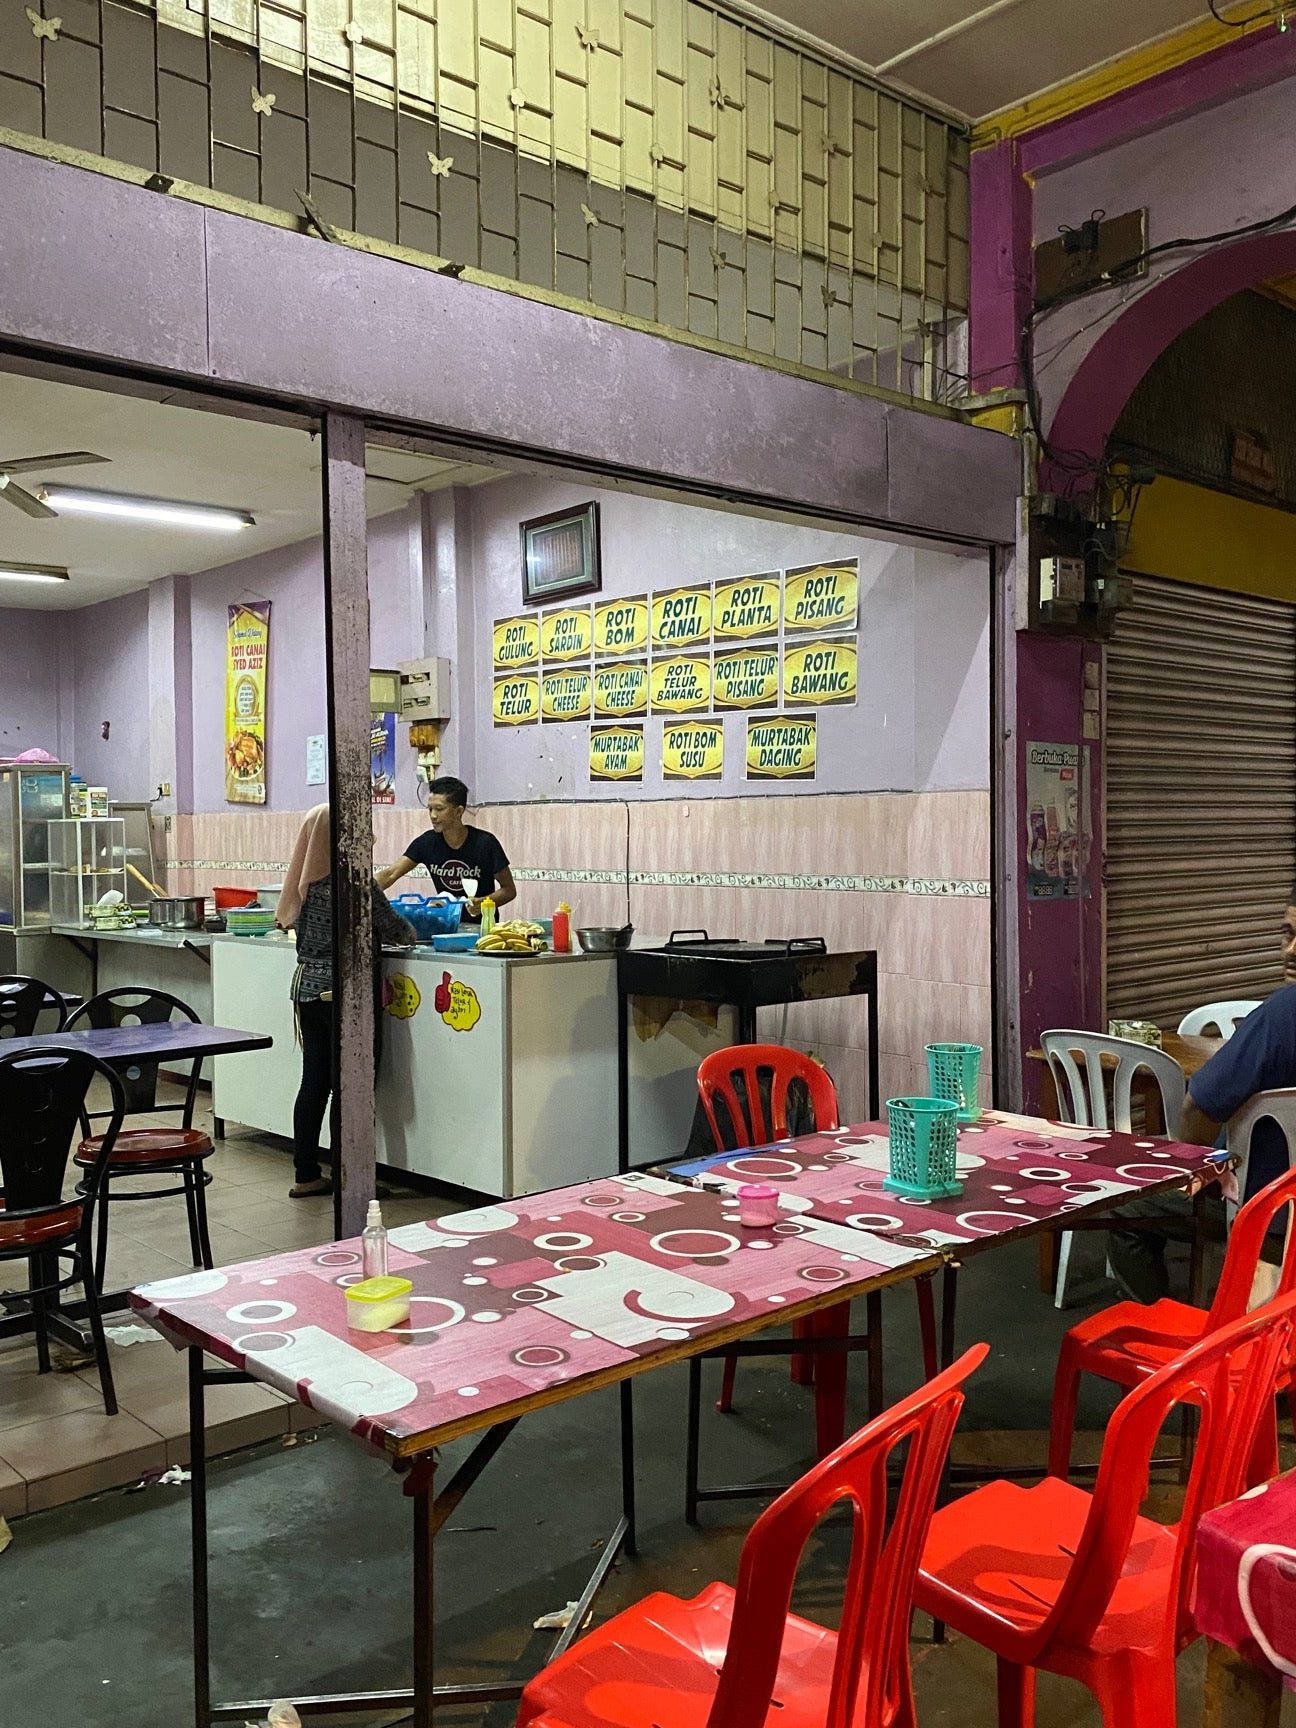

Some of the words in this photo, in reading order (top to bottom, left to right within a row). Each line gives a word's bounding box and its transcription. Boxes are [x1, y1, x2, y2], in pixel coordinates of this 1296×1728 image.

[804, 576, 837, 598] ROTI
[731, 586, 764, 608] ROTI
[662, 596, 698, 619] ROTI
[721, 605, 772, 628] PLANTA
[794, 596, 846, 621] PISANG
[554, 617, 578, 636] ROTI
[605, 608, 635, 628] ROTI
[505, 626, 526, 645] ROTI
[605, 626, 635, 645] BOM
[658, 617, 702, 640] CANAI
[246, 644, 265, 655] CANAI
[498, 642, 533, 661] GULUNG
[548, 634, 583, 653] SARDIN
[233, 660, 247, 670] SYED
[249, 658, 263, 669] AZIZ
[666, 664, 693, 677] ROTI
[716, 660, 741, 680] ROTI
[742, 656, 775, 678] TELUR
[803, 651, 837, 672] ROTI
[545, 681, 564, 696] ROTI
[565, 678, 588, 694] TELUR
[598, 674, 617, 690] ROTI
[618, 670, 643, 688] CANAI
[663, 676, 697, 688] TELUR
[725, 678, 765, 698] PISANG
[790, 671, 849, 696] BAWANG
[503, 682, 528, 699] ROTI
[605, 689, 636, 707] CHEESE
[657, 688, 703, 701] BAWANG
[499, 699, 531, 715] TELUR
[552, 695, 580, 712] CHEESE
[593, 735, 639, 753] MURTABAK
[668, 732, 692, 749] ROTI
[692, 730, 717, 749] BOM
[751, 727, 811, 747] MURTABAK
[604, 752, 627, 770] AYAM
[679, 750, 706, 768] SUSU
[759, 748, 802, 767] DAGING
[1032, 749, 1062, 764] Berbuka
[430, 864, 455, 876] Hard
[456, 866, 481, 877] Rock
